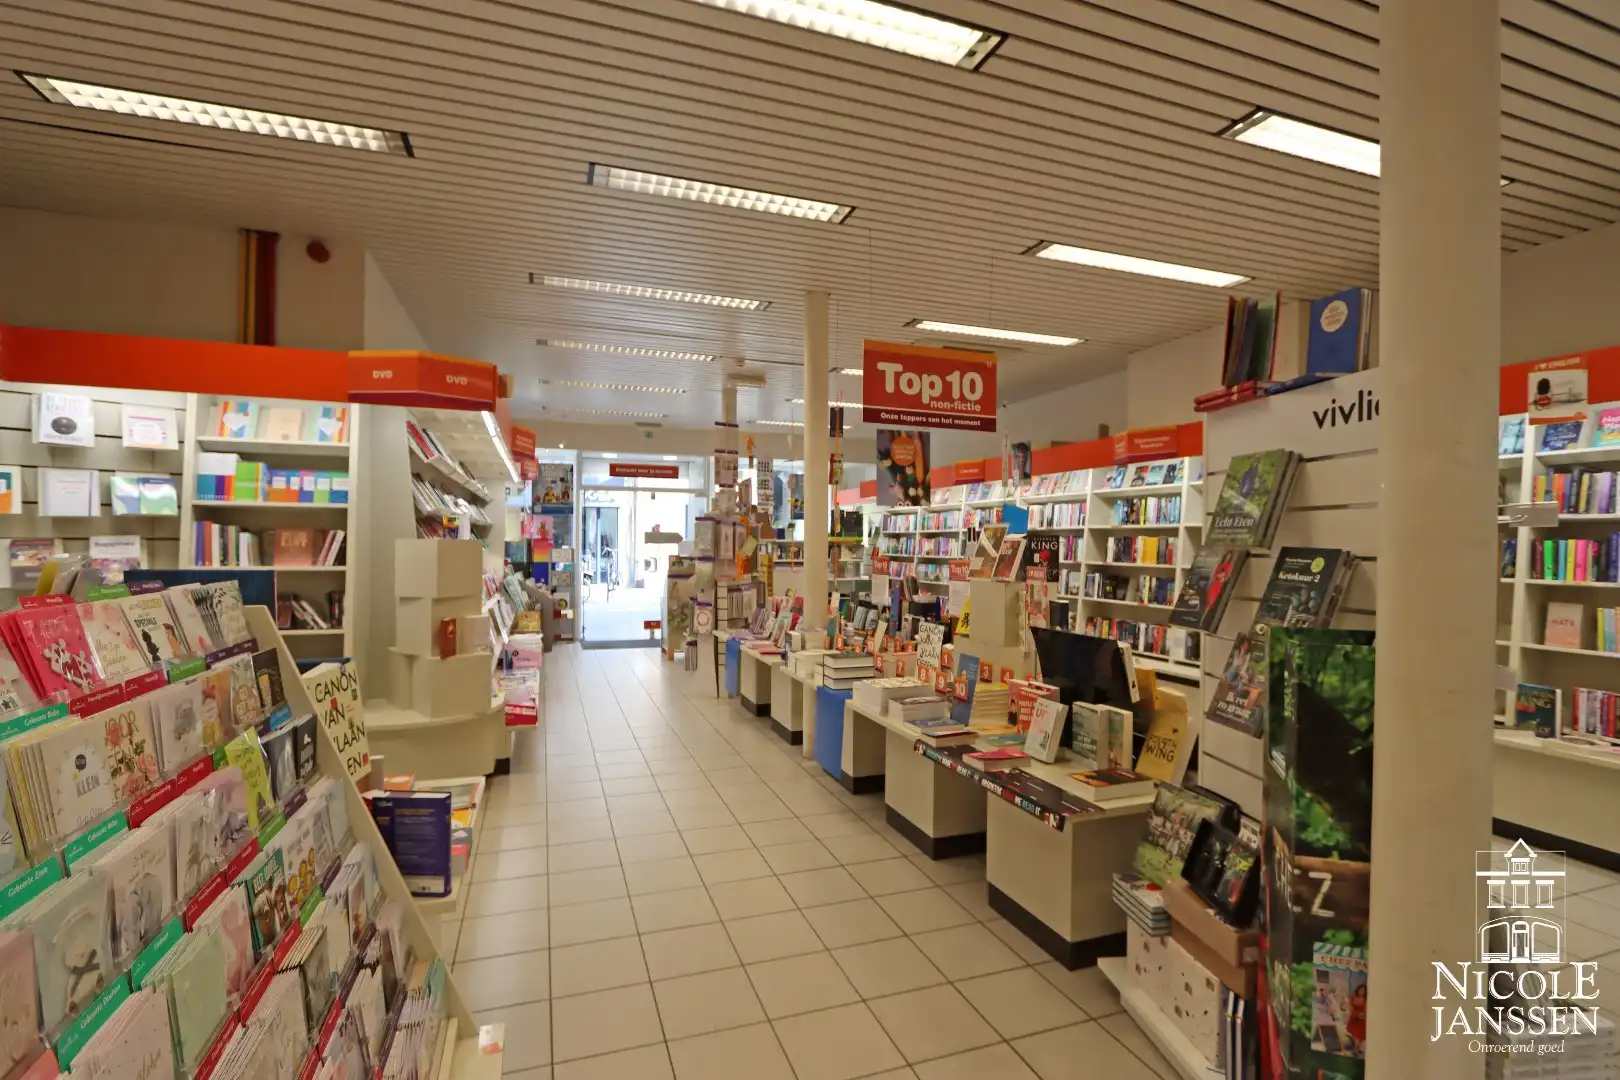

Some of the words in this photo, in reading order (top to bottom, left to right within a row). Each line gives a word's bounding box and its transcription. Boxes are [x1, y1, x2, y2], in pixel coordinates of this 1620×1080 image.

[372, 370, 393, 379] DVD
[446, 375, 468, 385] DVD
[877, 361, 942, 404] Top
[946, 370, 983, 401] 10
[930, 400, 981, 412] non-fictie
[900, 414, 927, 423] toppers
[1031, 541, 1058, 550] KING
[951, 564, 961, 575] Top
[1278, 571, 1314, 582] Ketokuur
[919, 624, 944, 636] CANON
[920, 668, 926, 678] 8
[983, 666, 989, 677] 3
[1003, 672, 1010, 681] 4
[314, 668, 358, 703] CANON
[938, 676, 945, 688] 9
[955, 682, 966, 697] 10
[1145, 744, 1176, 763] WING
[75, 774, 100, 797] KLEIN
[1035, 806, 1042, 816] IT
